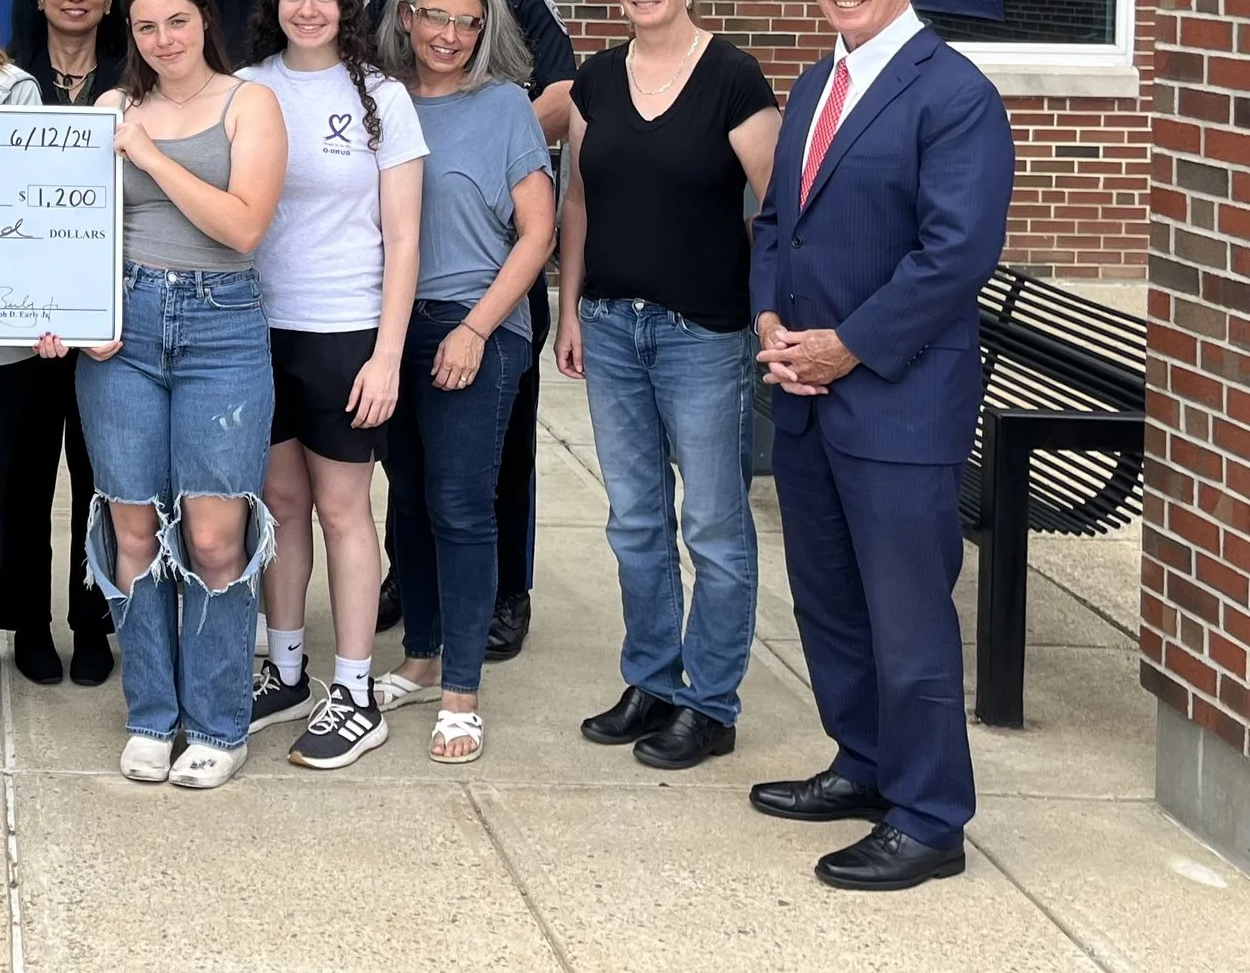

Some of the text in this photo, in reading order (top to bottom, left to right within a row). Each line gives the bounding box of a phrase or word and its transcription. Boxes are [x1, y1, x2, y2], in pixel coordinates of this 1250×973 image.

[10, 125, 91, 152] 6/12/24
[19, 191, 26, 201] $
[38, 188, 97, 208] 1,200
[49, 229, 106, 239] DOLLARS
[19, 311, 39, 320] Early
